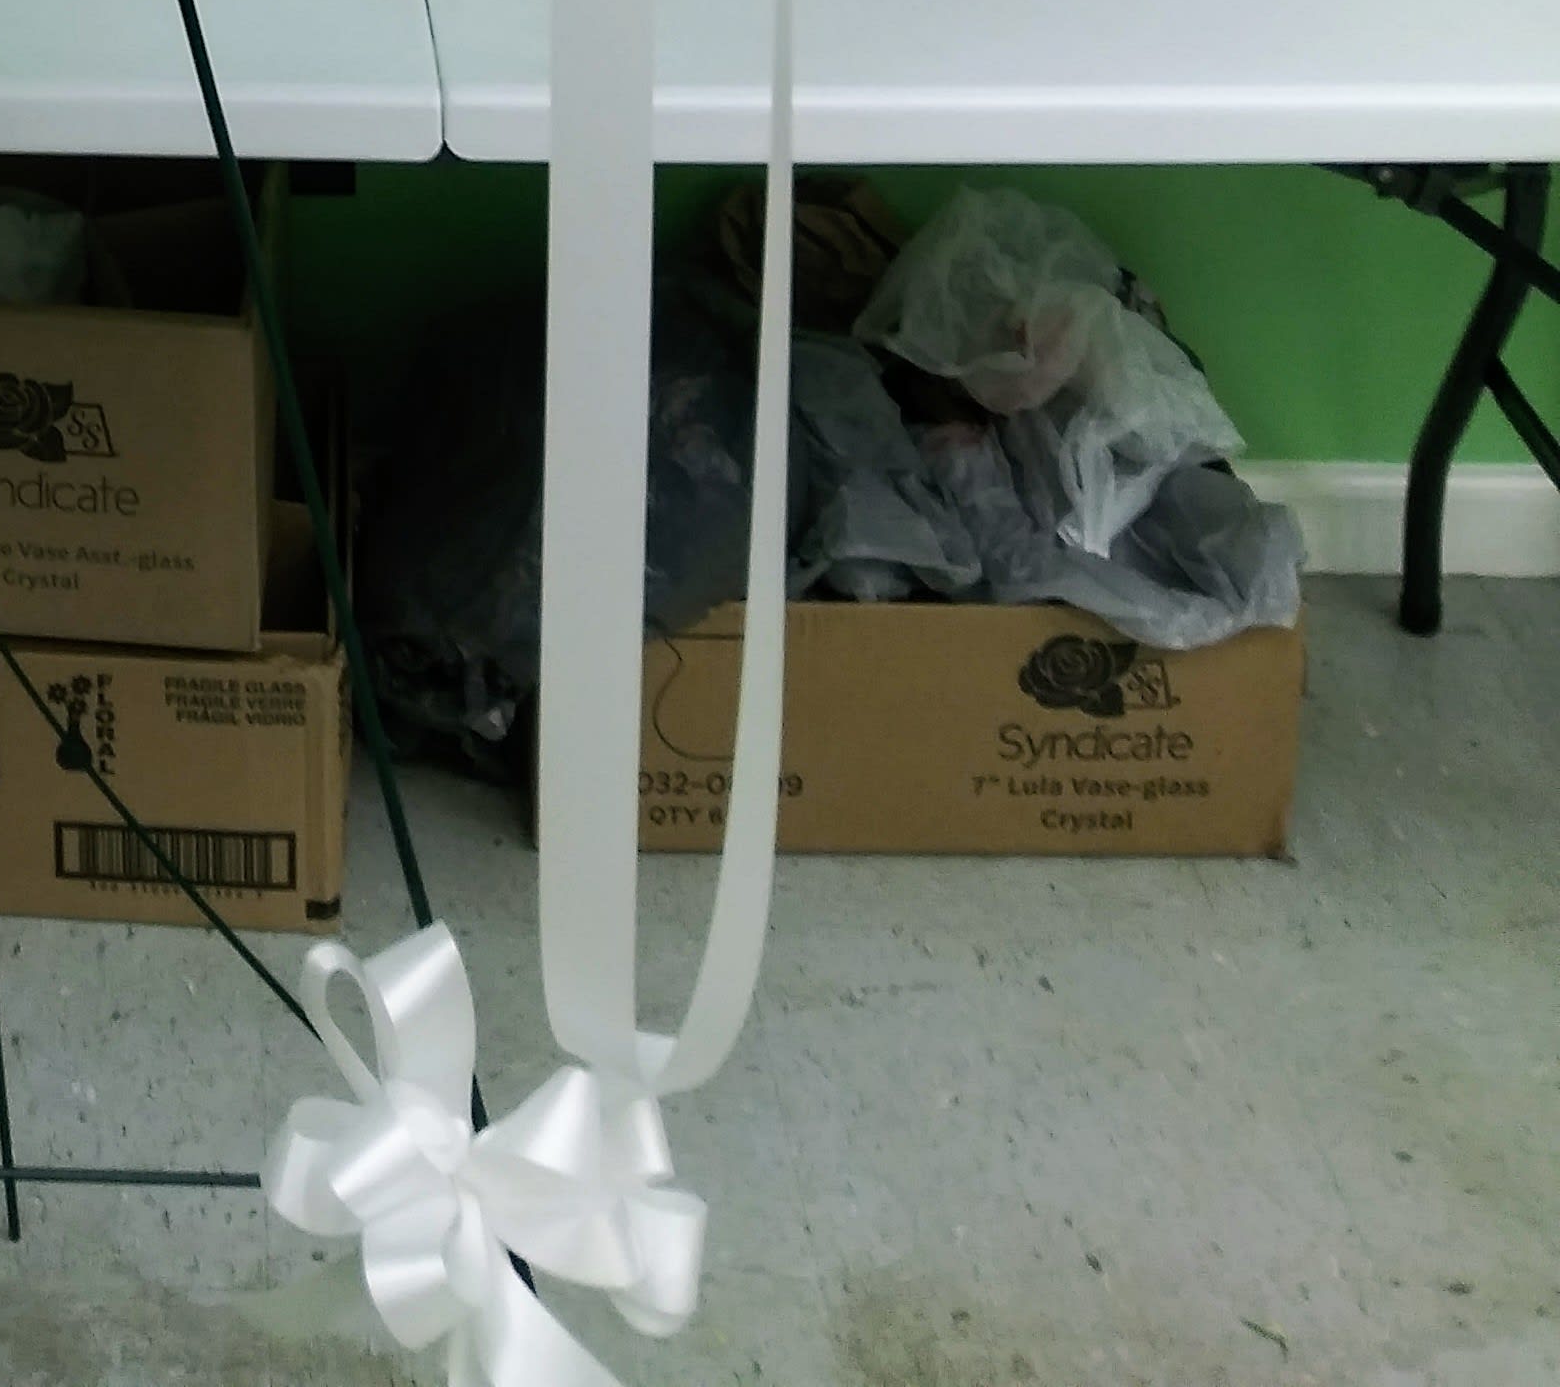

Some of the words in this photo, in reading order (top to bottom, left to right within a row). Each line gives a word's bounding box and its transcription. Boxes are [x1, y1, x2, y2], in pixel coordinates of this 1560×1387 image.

[17, 540, 69, 561] Vase
[2, 567, 81, 593] Crystal
[164, 676, 240, 693] FRAGILE
[997, 722, 1195, 770] Syndicate
[1007, 774, 1064, 797] Lula
[648, 804, 703, 827] QTY
[1040, 808, 1133, 834] Crystal
